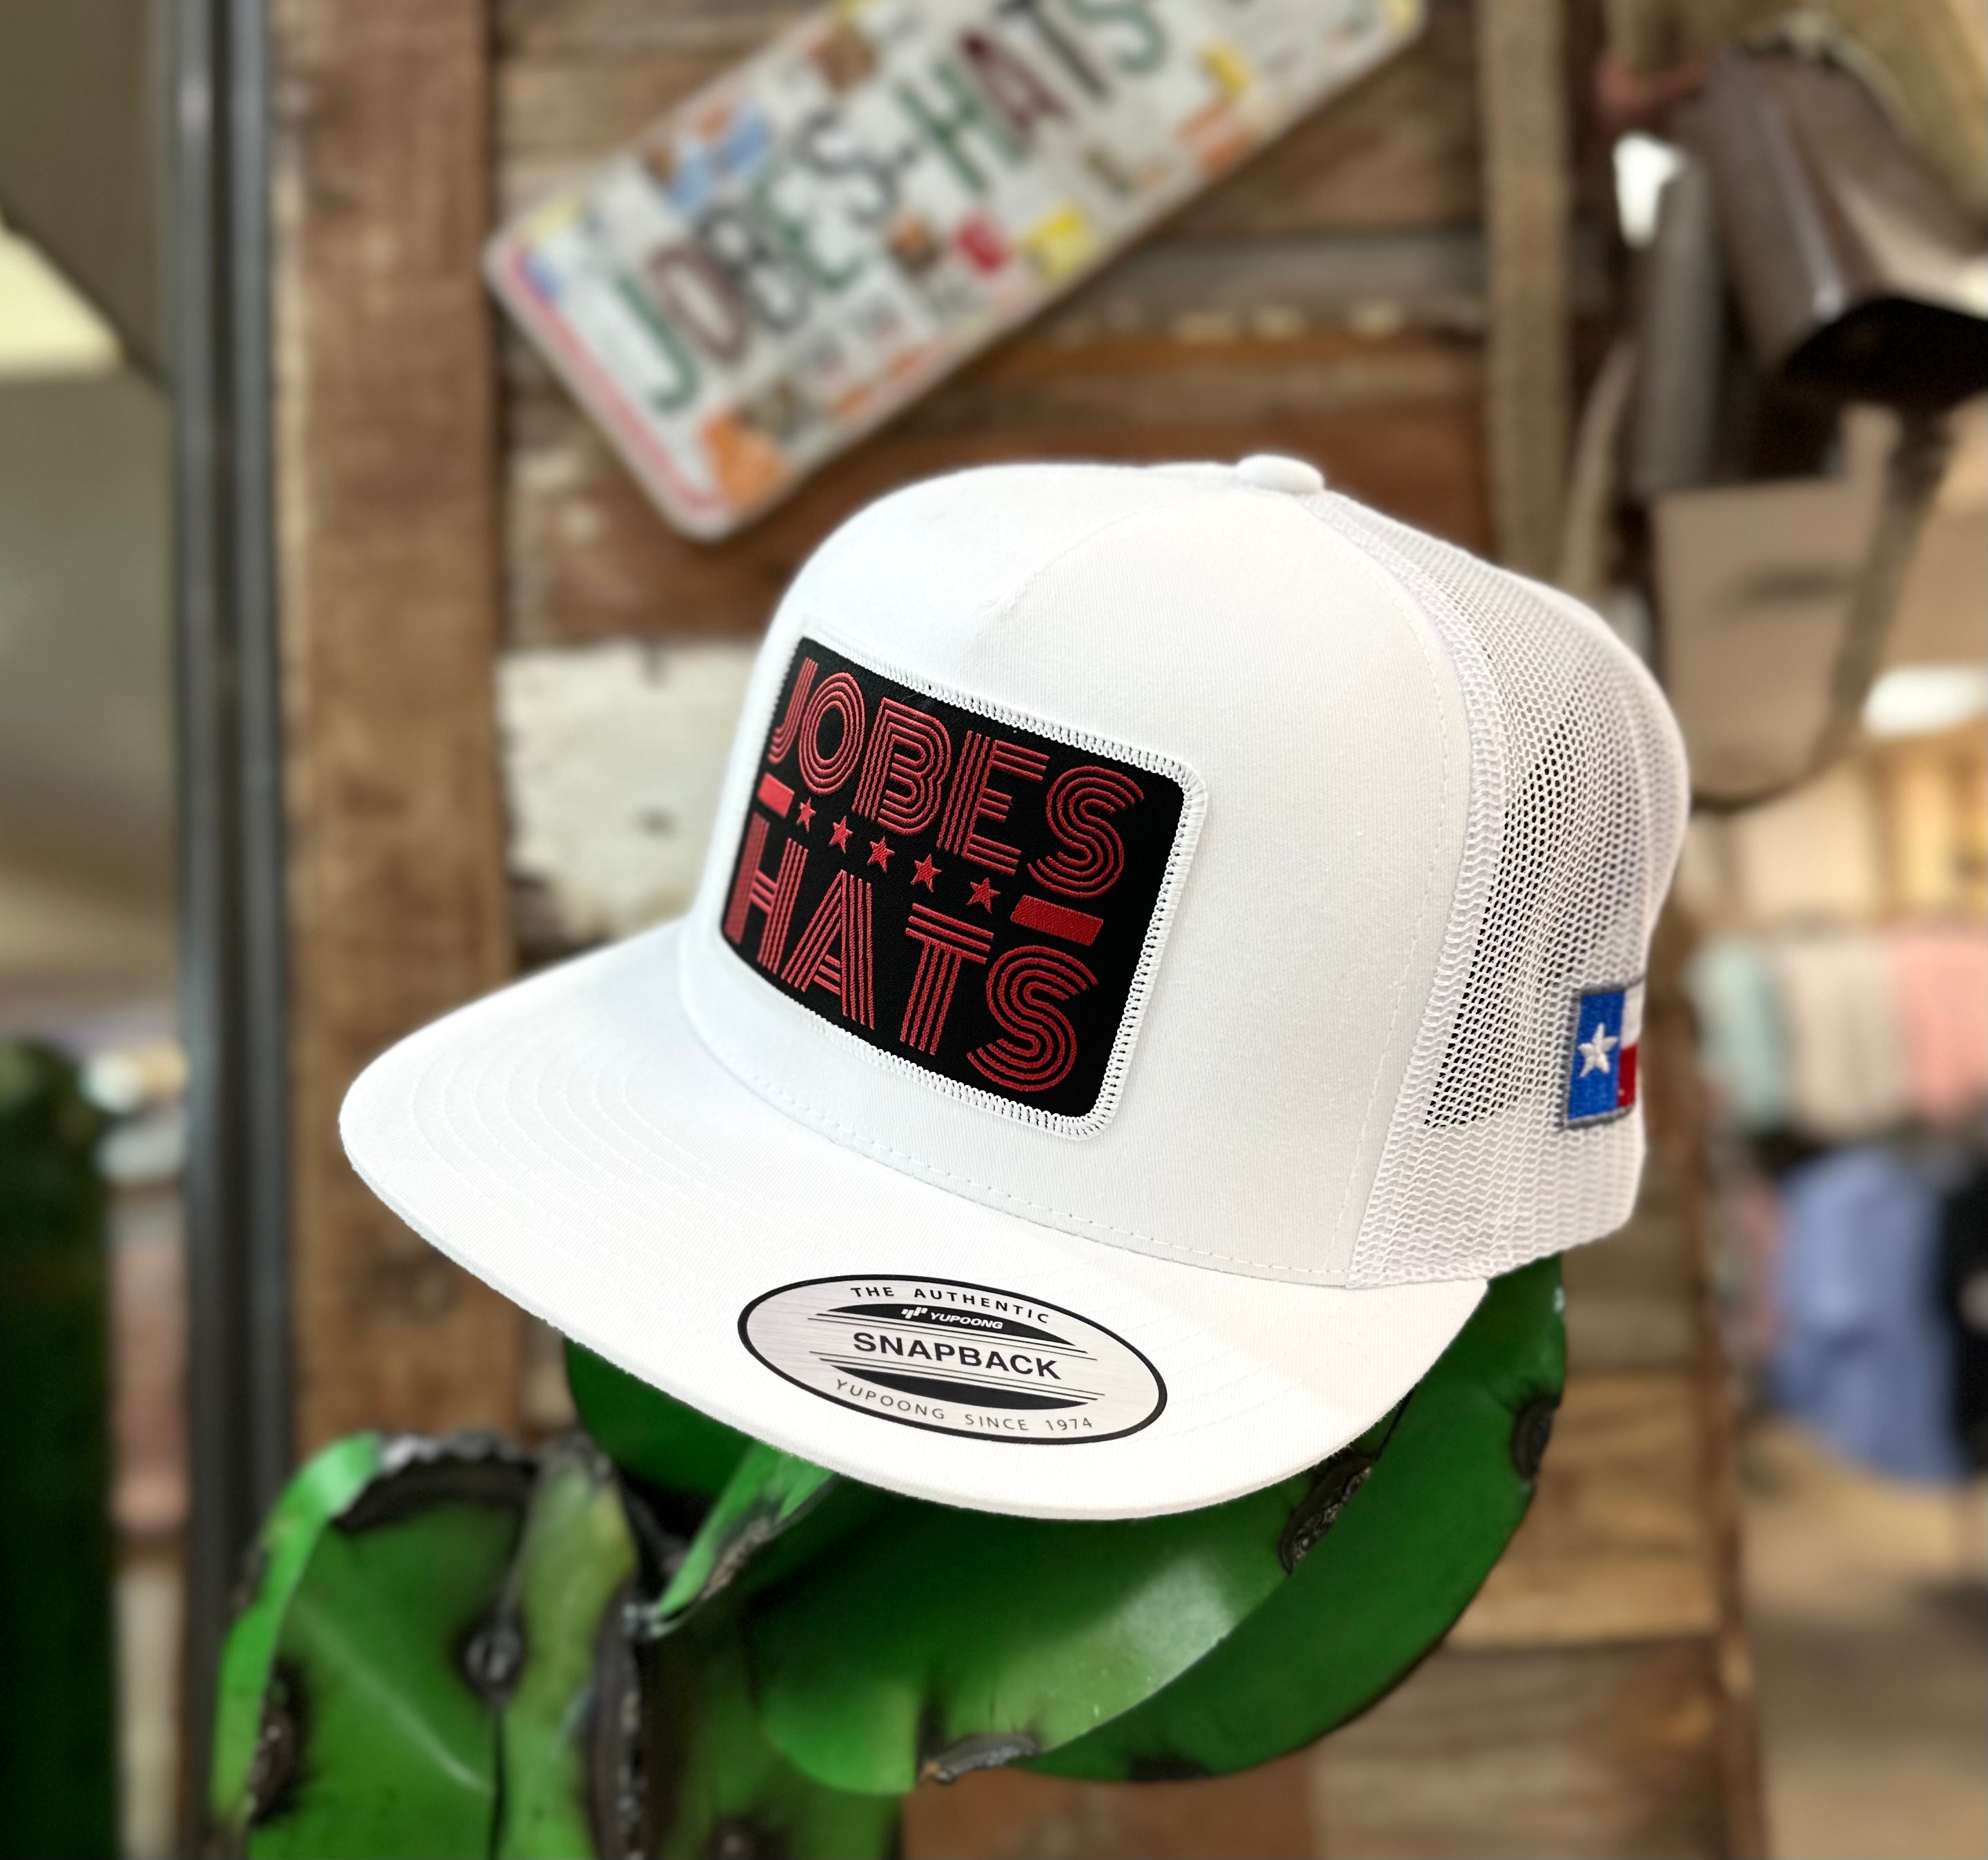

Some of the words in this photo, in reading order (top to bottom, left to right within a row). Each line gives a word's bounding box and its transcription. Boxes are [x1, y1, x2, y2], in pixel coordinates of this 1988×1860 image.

[768, 656, 1145, 898] JOBES
[722, 812, 1099, 1092] HATS
[850, 1286, 894, 1298] THE
[914, 1288, 1049, 1324] AUTHENTIC
[930, 1311, 1004, 1329] YUPOONG
[853, 1332, 1062, 1380] SNAPBACK
[836, 1378, 945, 1420] YUPOONG
[965, 1413, 1029, 1431] SINCE
[1045, 1417, 1093, 1431] 1974
